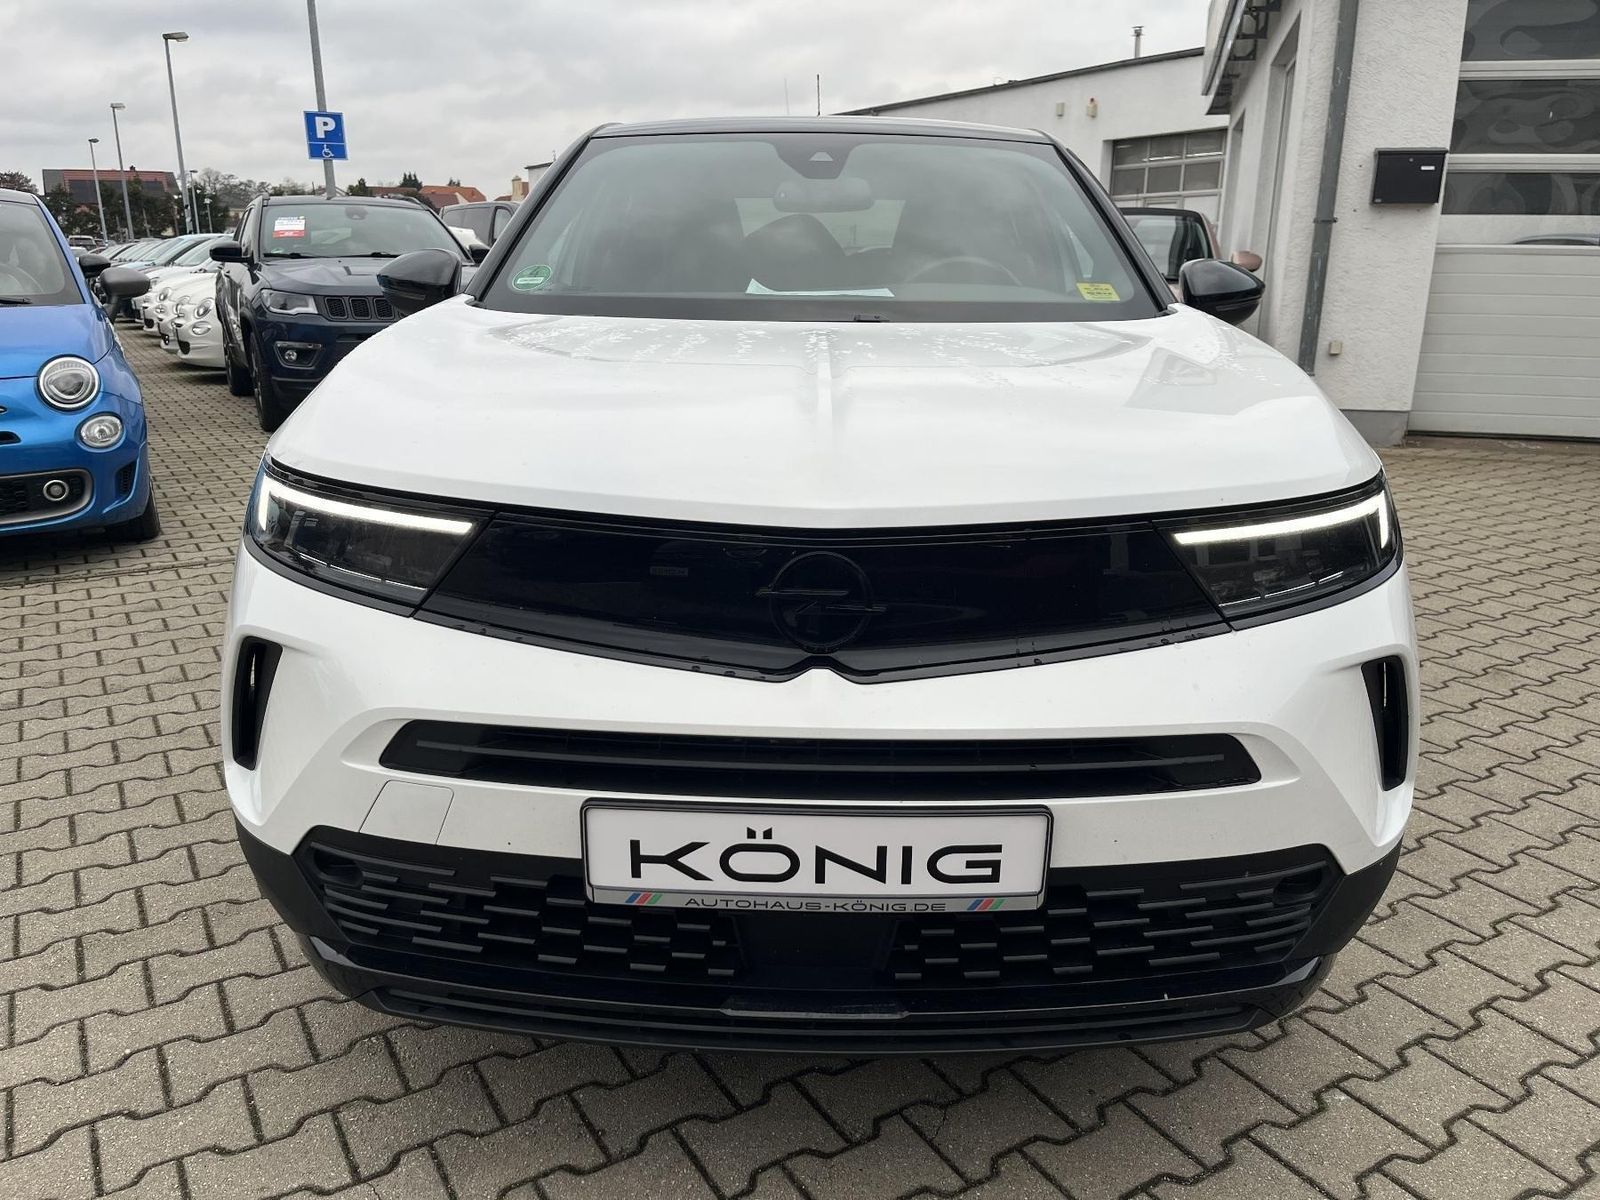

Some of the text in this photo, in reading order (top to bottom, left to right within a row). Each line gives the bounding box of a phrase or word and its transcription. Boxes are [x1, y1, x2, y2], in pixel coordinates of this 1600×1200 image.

[315, 116, 336, 138] P
[630, 827, 1003, 884] KÖNIG
[685, 898, 946, 912] AUTOHAUS-KÖNIG.DE
